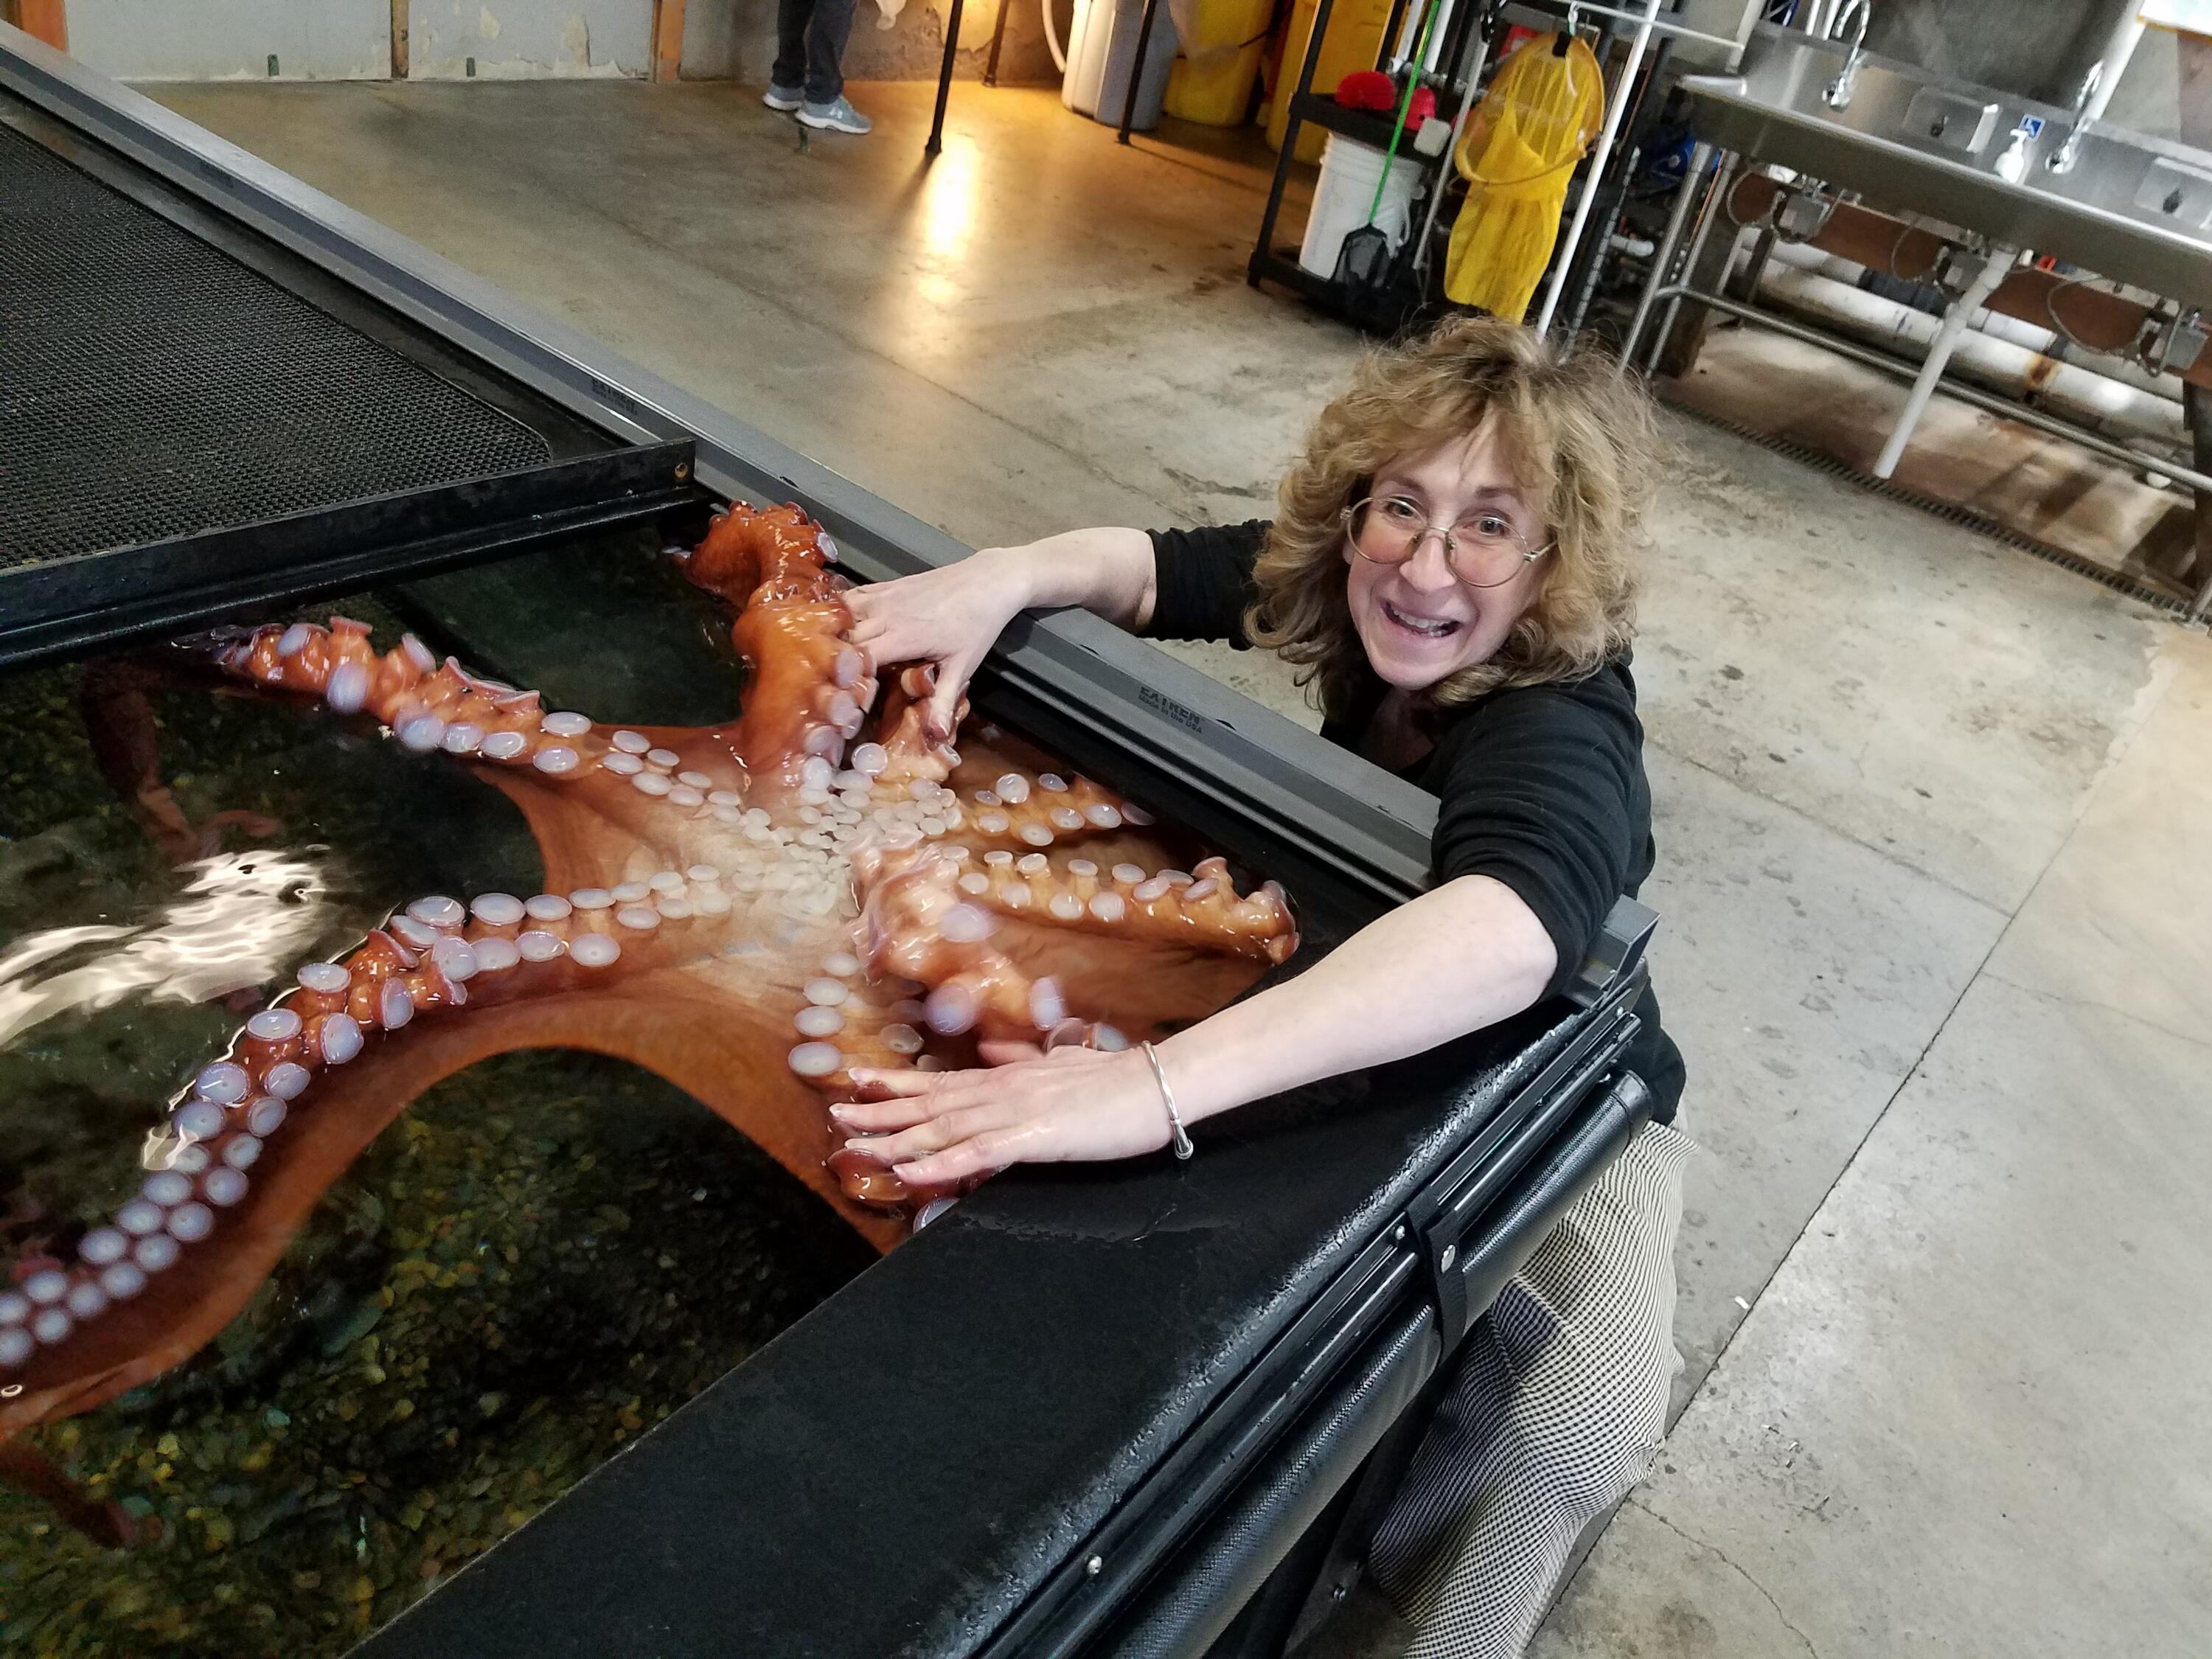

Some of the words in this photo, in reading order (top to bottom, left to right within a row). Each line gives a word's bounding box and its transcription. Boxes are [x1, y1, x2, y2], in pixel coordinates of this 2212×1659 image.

[1161, 707, 1169, 715] in
[1170, 712, 1183, 723] the
[1185, 720, 1202, 734] USA
